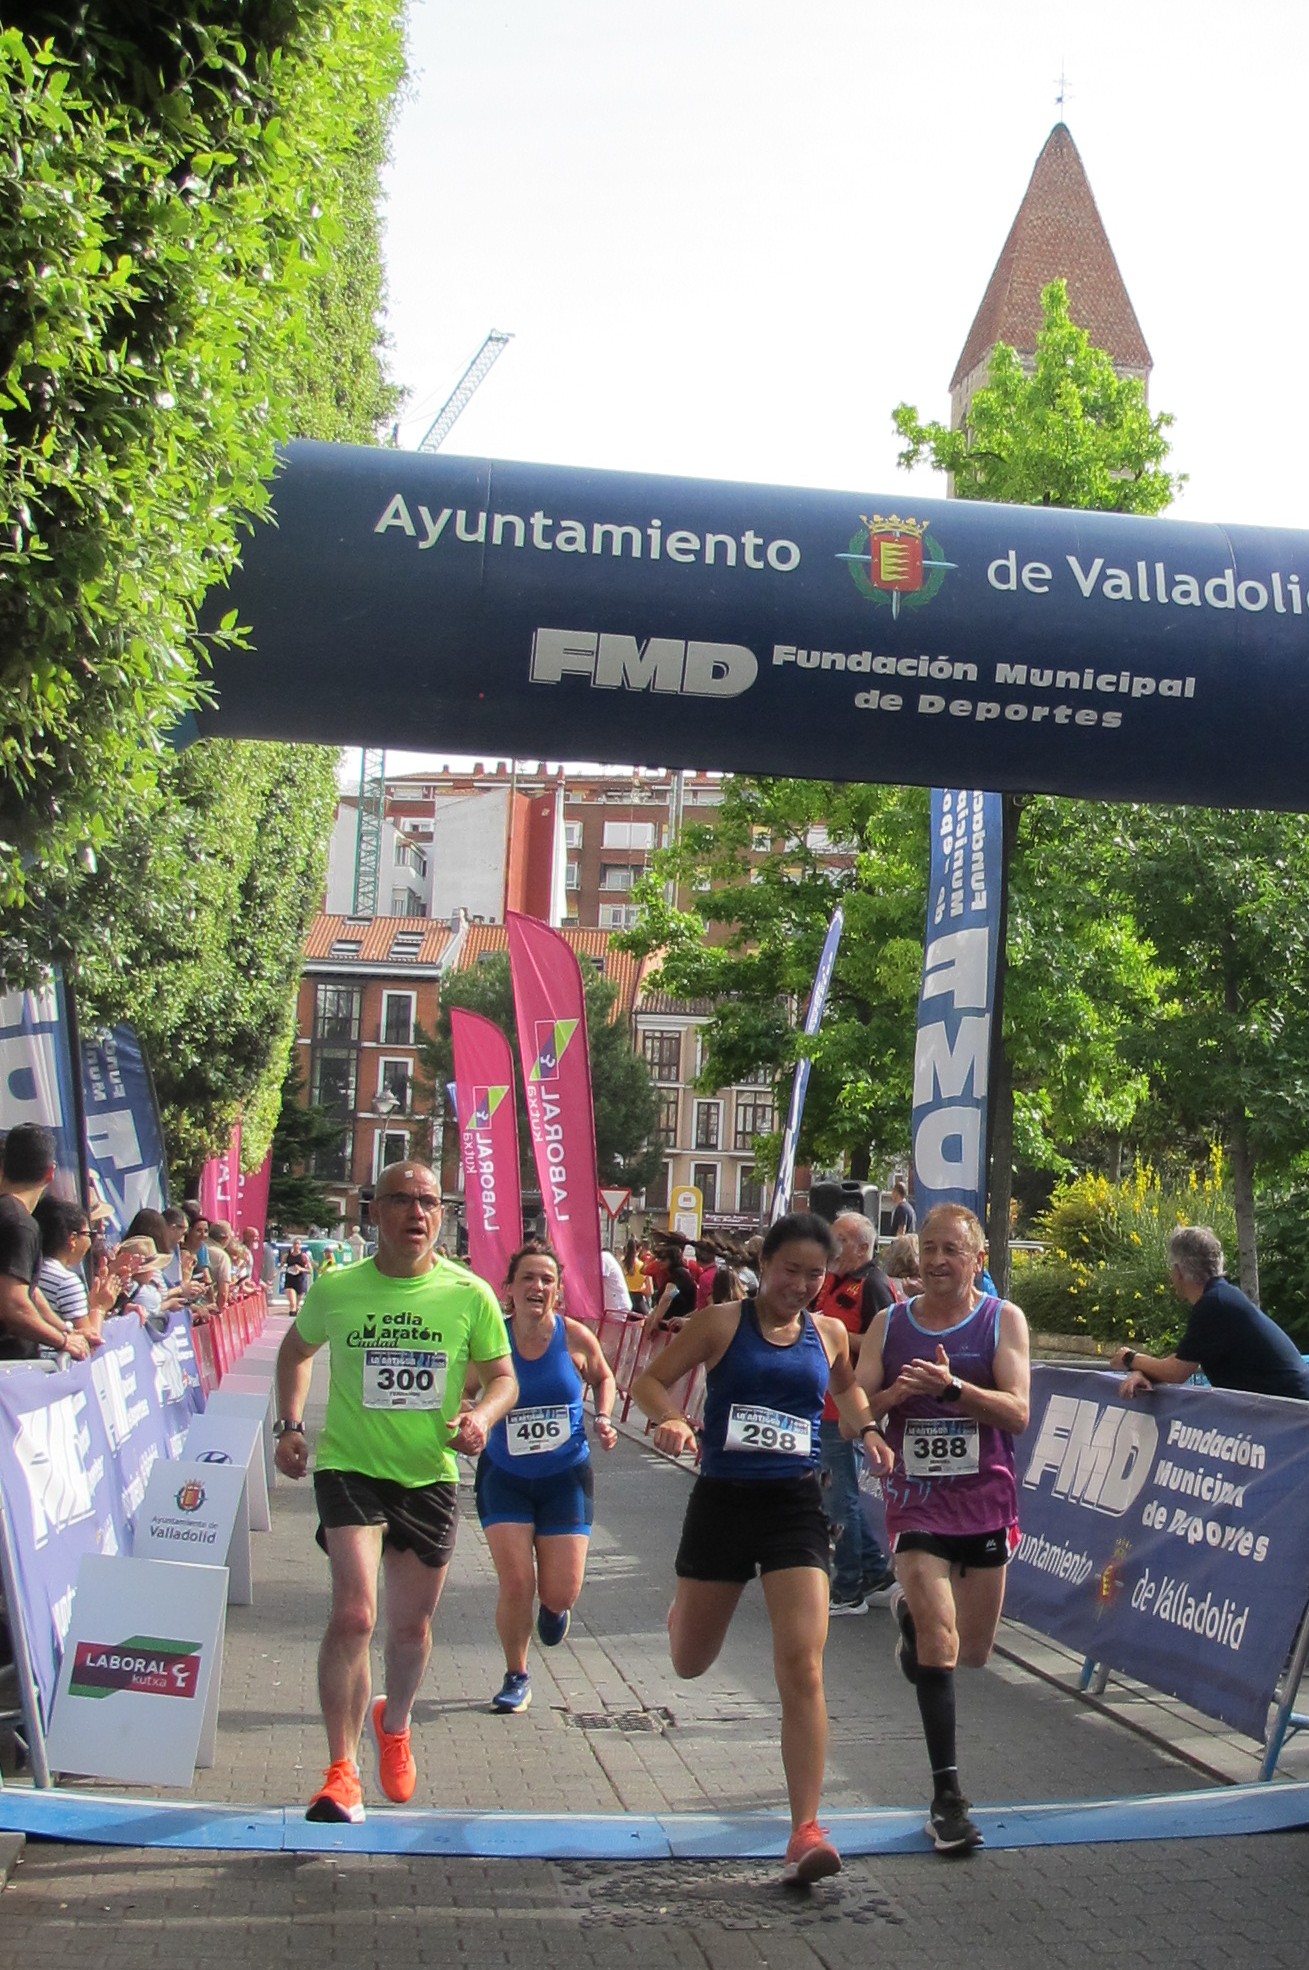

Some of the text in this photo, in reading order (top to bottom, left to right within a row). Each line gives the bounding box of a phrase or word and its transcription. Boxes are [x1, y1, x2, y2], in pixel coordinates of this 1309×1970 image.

[374, 494, 1309, 614] Ayuntamiento de Valladoli
[529, 627, 758, 698] FMD
[772, 645, 1196, 698] Fundación Municipal
[854, 690, 1123, 729] de Deportes
[377, 1368, 434, 1391] 300
[517, 1421, 560, 1440] 406
[741, 1424, 797, 1451] 298
[1167, 1420, 1266, 1470] Fundación
[914, 1436, 967, 1459] 388
[1022, 1394, 1159, 1517] FMD
[1142, 1500, 1168, 1530] de
[150, 1525, 216, 1544] Valladolid
[1131, 1568, 1155, 1612] de
[1153, 1576, 1250, 1651] Valladolid
[86, 1653, 168, 1676] LABORAL
[132, 1674, 167, 1688] kutxa
